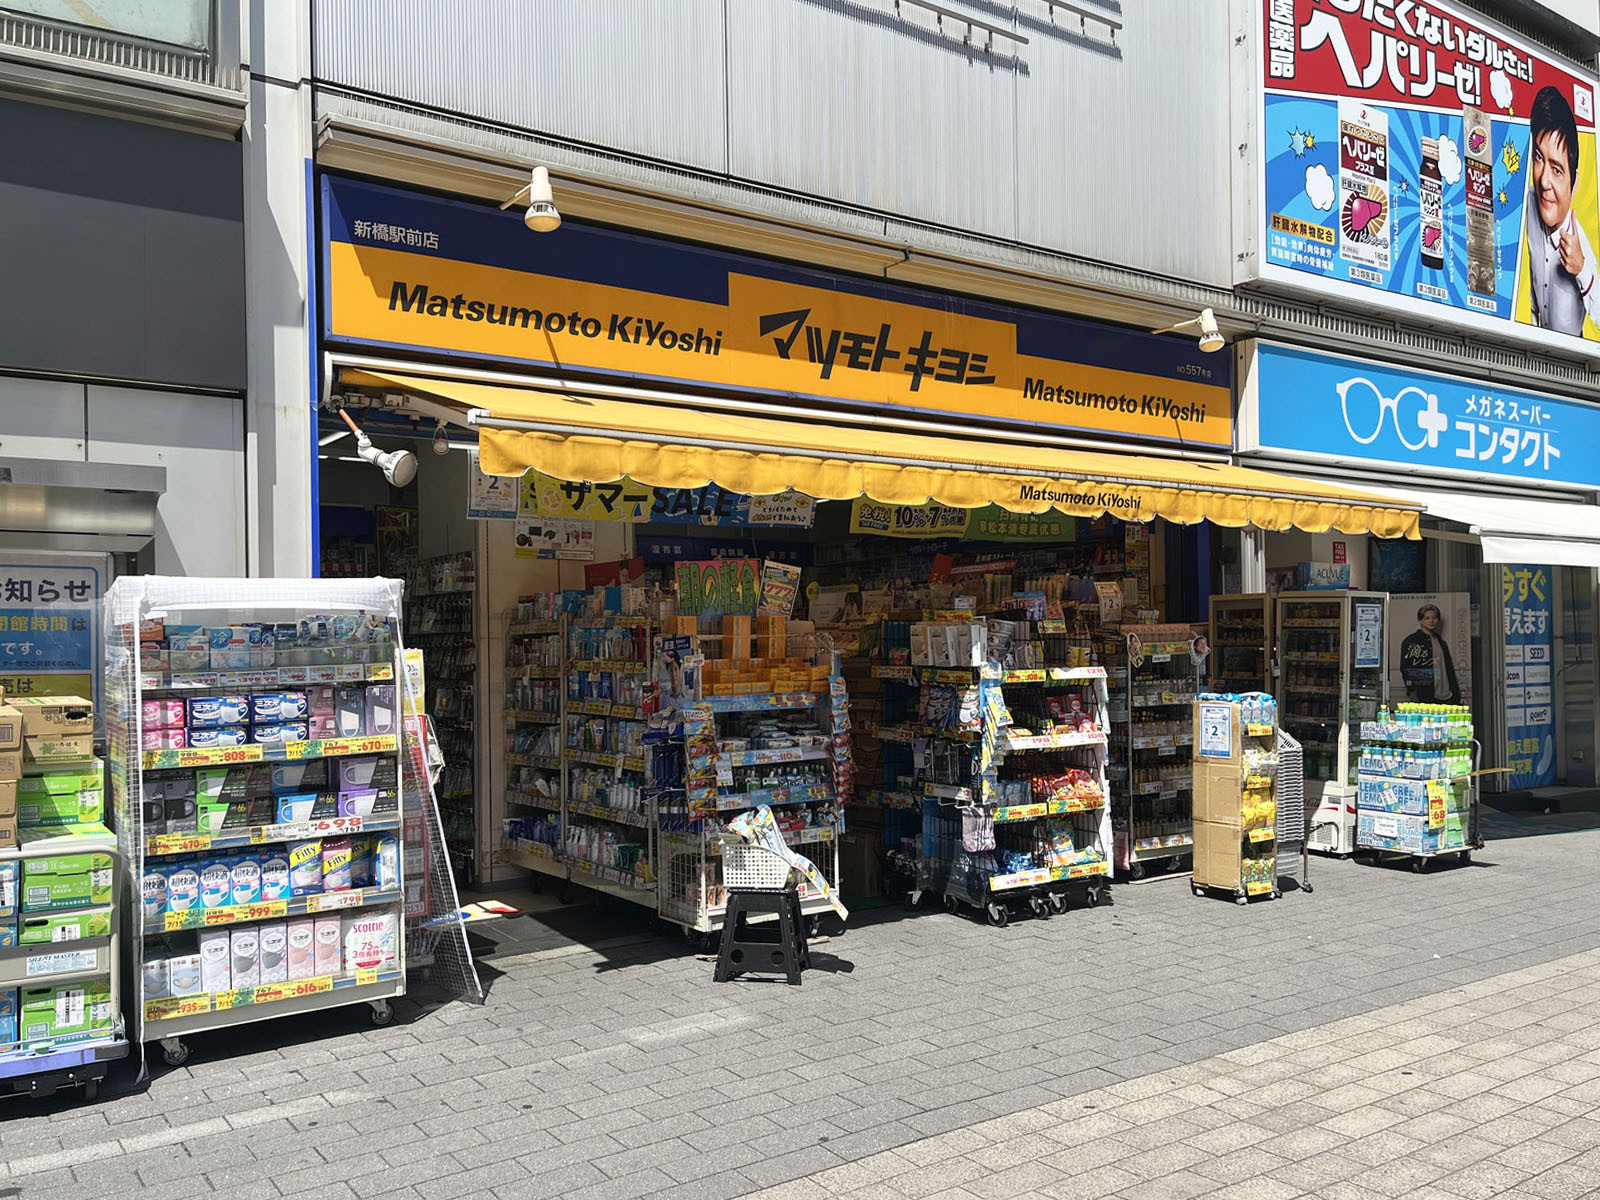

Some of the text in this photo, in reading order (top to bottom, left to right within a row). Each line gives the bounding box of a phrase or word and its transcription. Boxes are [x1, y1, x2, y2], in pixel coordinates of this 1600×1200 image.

[1300, 9, 1482, 105] ヘパリーゼ!
[1342, 135, 1386, 168] ヘパリーゼ
[354, 219, 439, 250] 新橋駅前店
[1273, 215, 1333, 243] 肝臓水解物配合
[388, 281, 722, 356] Matsumoto KiYoshi
[1023, 377, 1206, 424] Matsumoto KiYoshi
[1465, 394, 1551, 425] メガネスーパー
[1455, 421, 1560, 470] コンタクト
[651, 486, 733, 517] SALE
[1020, 485, 1142, 510] Matsumoto KiYoshi
[1316, 565, 1345, 582] ACUVUE
[0, 578, 91, 602] 知らせ
[212, 631, 228, 645] 冷
[1364, 629, 1371, 641] 2
[1529, 648, 1545, 660] SEED
[192, 702, 220, 711] 三次元
[1211, 725, 1218, 736] 2
[362, 741, 381, 751] 670
[224, 751, 246, 762] 808
[1433, 809, 1446, 821] 68
[317, 817, 362, 830] 698
[295, 845, 317, 861] Fitty
[327, 853, 347, 868] Fitty
[202, 871, 228, 881] 超快適
[234, 868, 258, 879] 超快適
[171, 877, 197, 887] 超快適
[343, 896, 361, 904] 798
[249, 907, 270, 918] 999
[297, 982, 317, 994] 616
[180, 1002, 197, 1013] 935
